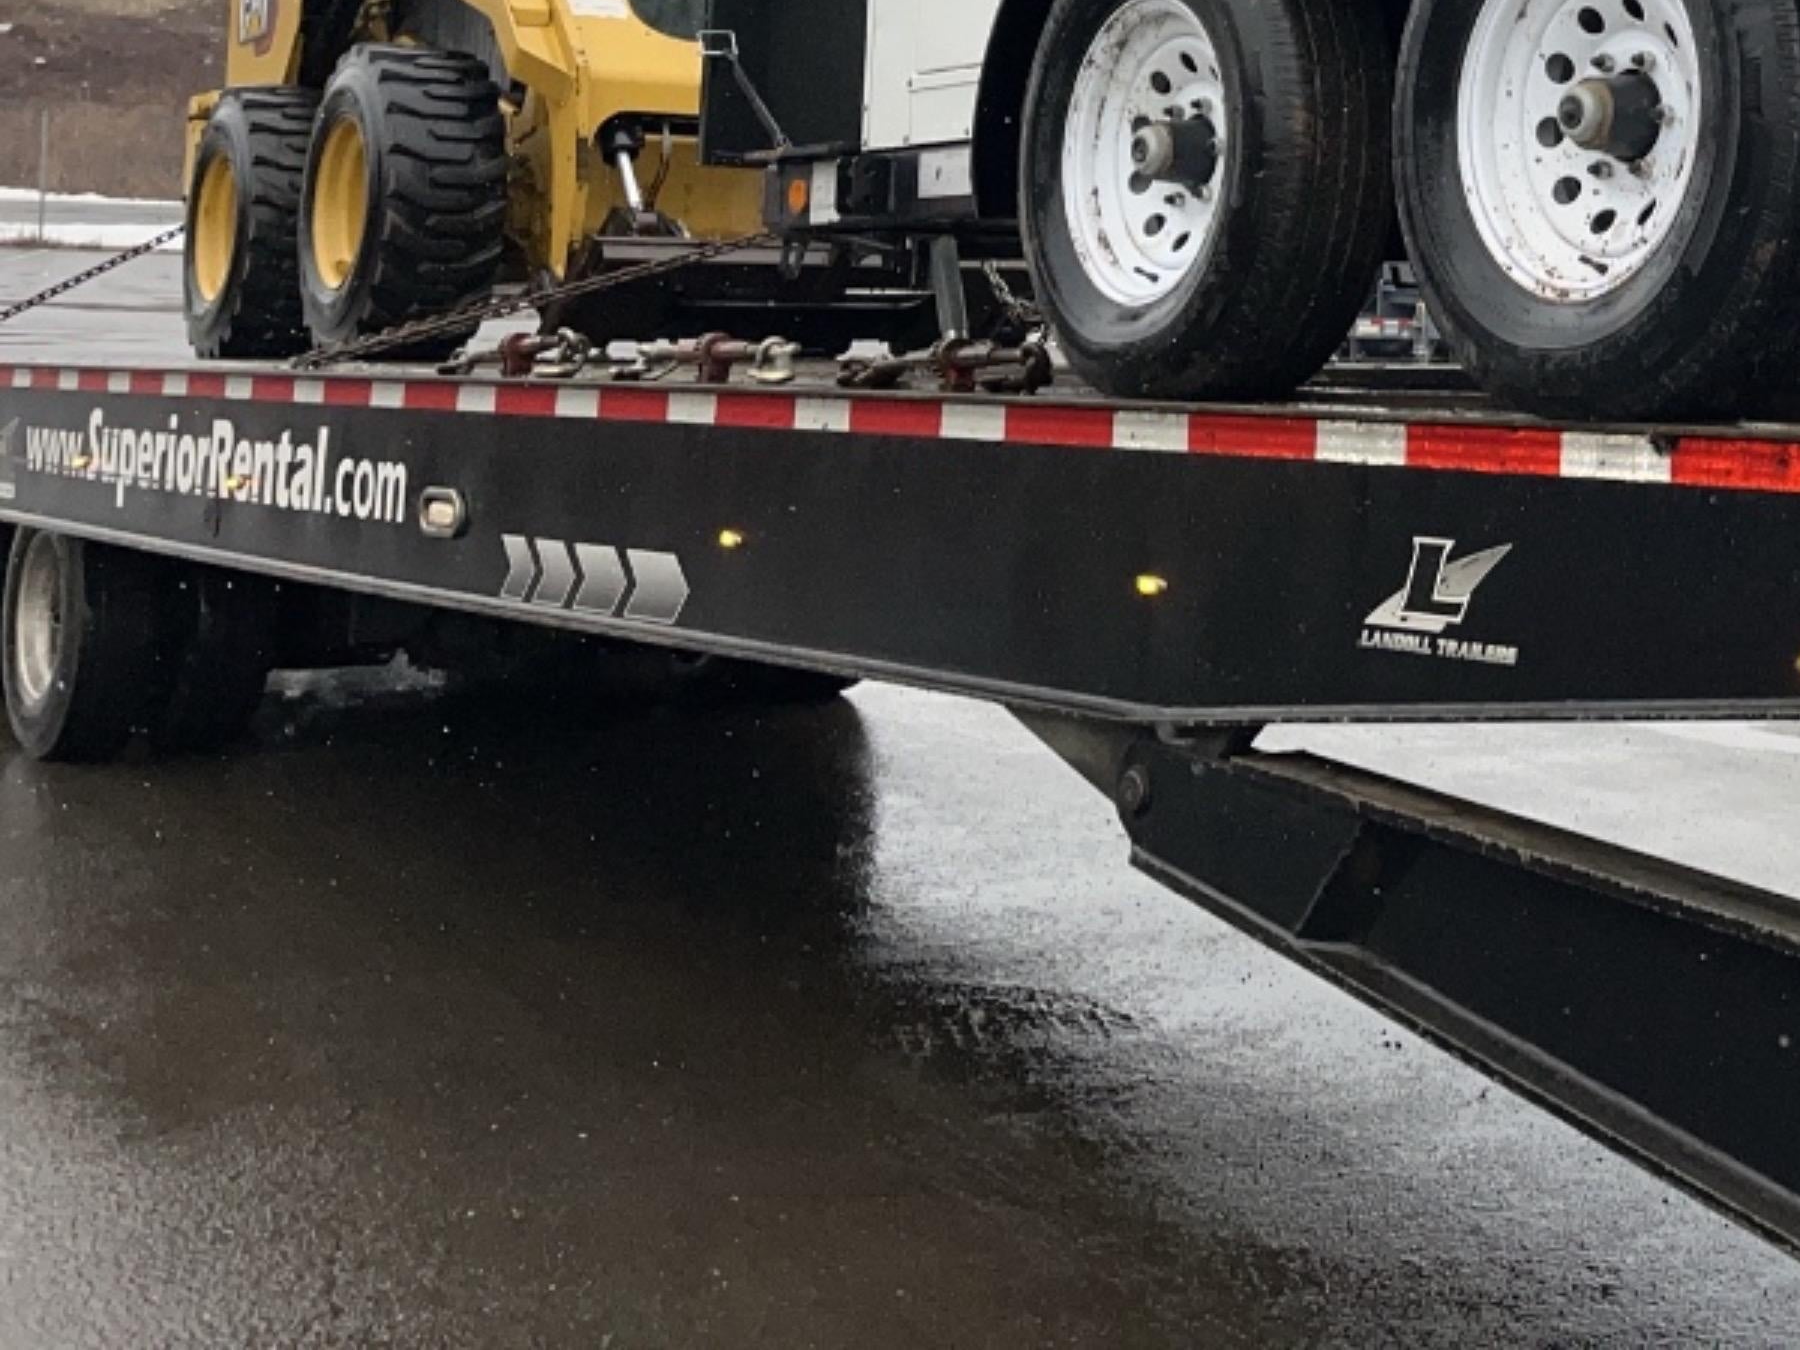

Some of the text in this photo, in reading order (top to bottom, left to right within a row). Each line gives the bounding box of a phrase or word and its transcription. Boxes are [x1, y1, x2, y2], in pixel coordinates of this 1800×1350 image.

[26, 406, 407, 523] www.SuperiorRental.com
[1360, 627, 1519, 668] LANDOLL TRAILERS
